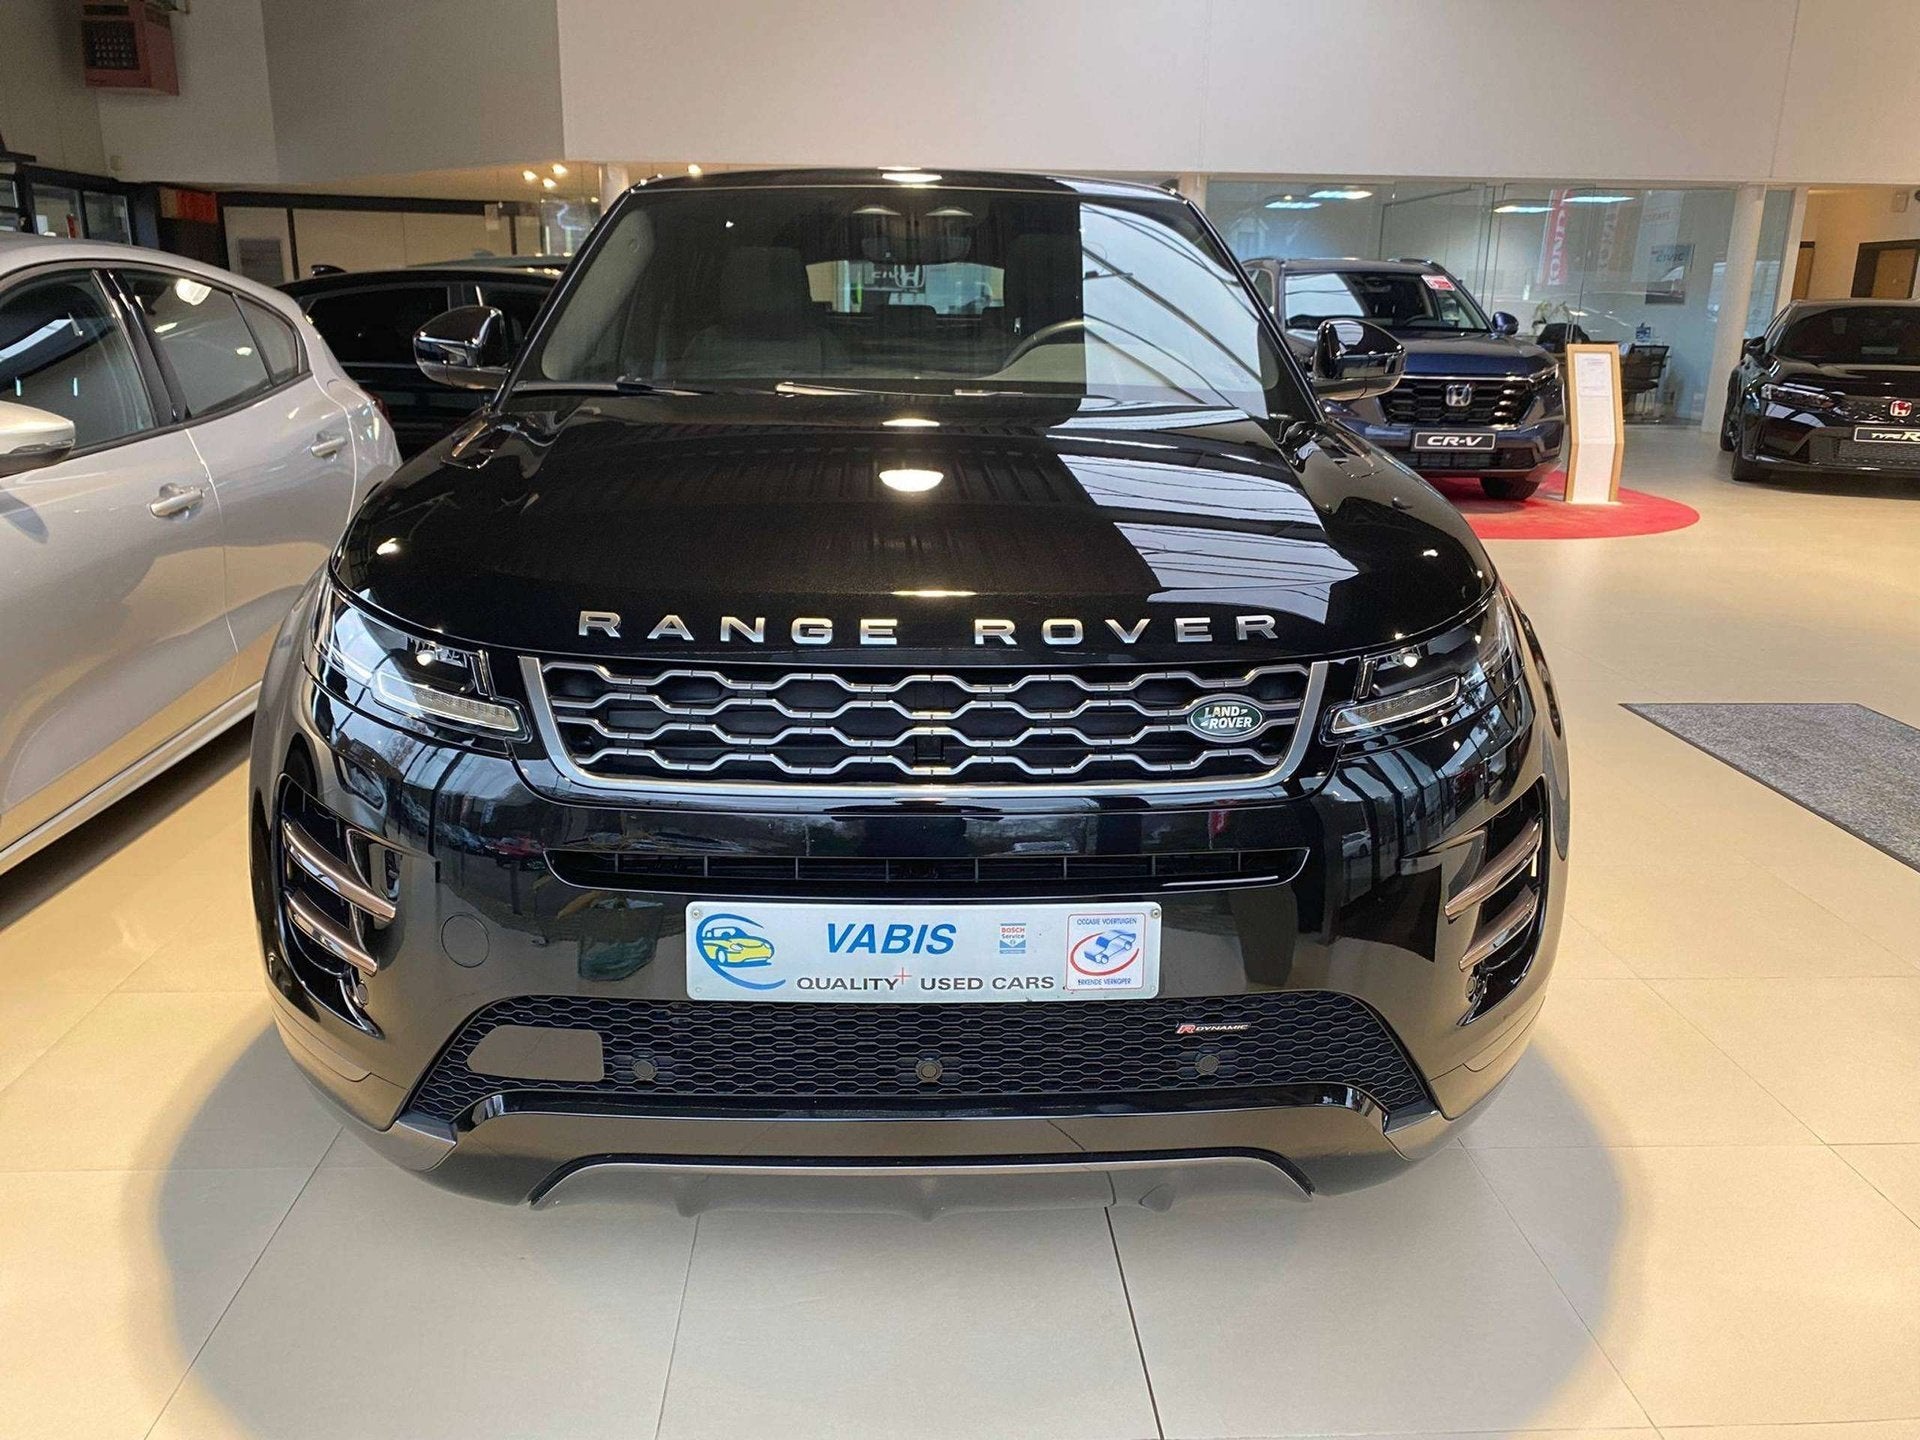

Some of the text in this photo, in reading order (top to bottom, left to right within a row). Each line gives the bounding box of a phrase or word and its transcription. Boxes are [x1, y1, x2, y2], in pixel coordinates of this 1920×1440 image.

[1426, 436, 1483, 446] CR-V
[577, 611, 1278, 646] RANGE ROVER
[1204, 706, 1240, 718] LAND
[1208, 716, 1253, 729] ROVER
[826, 923, 958, 955] VABIS
[796, 976, 1055, 991] QUALITY USED CARS
